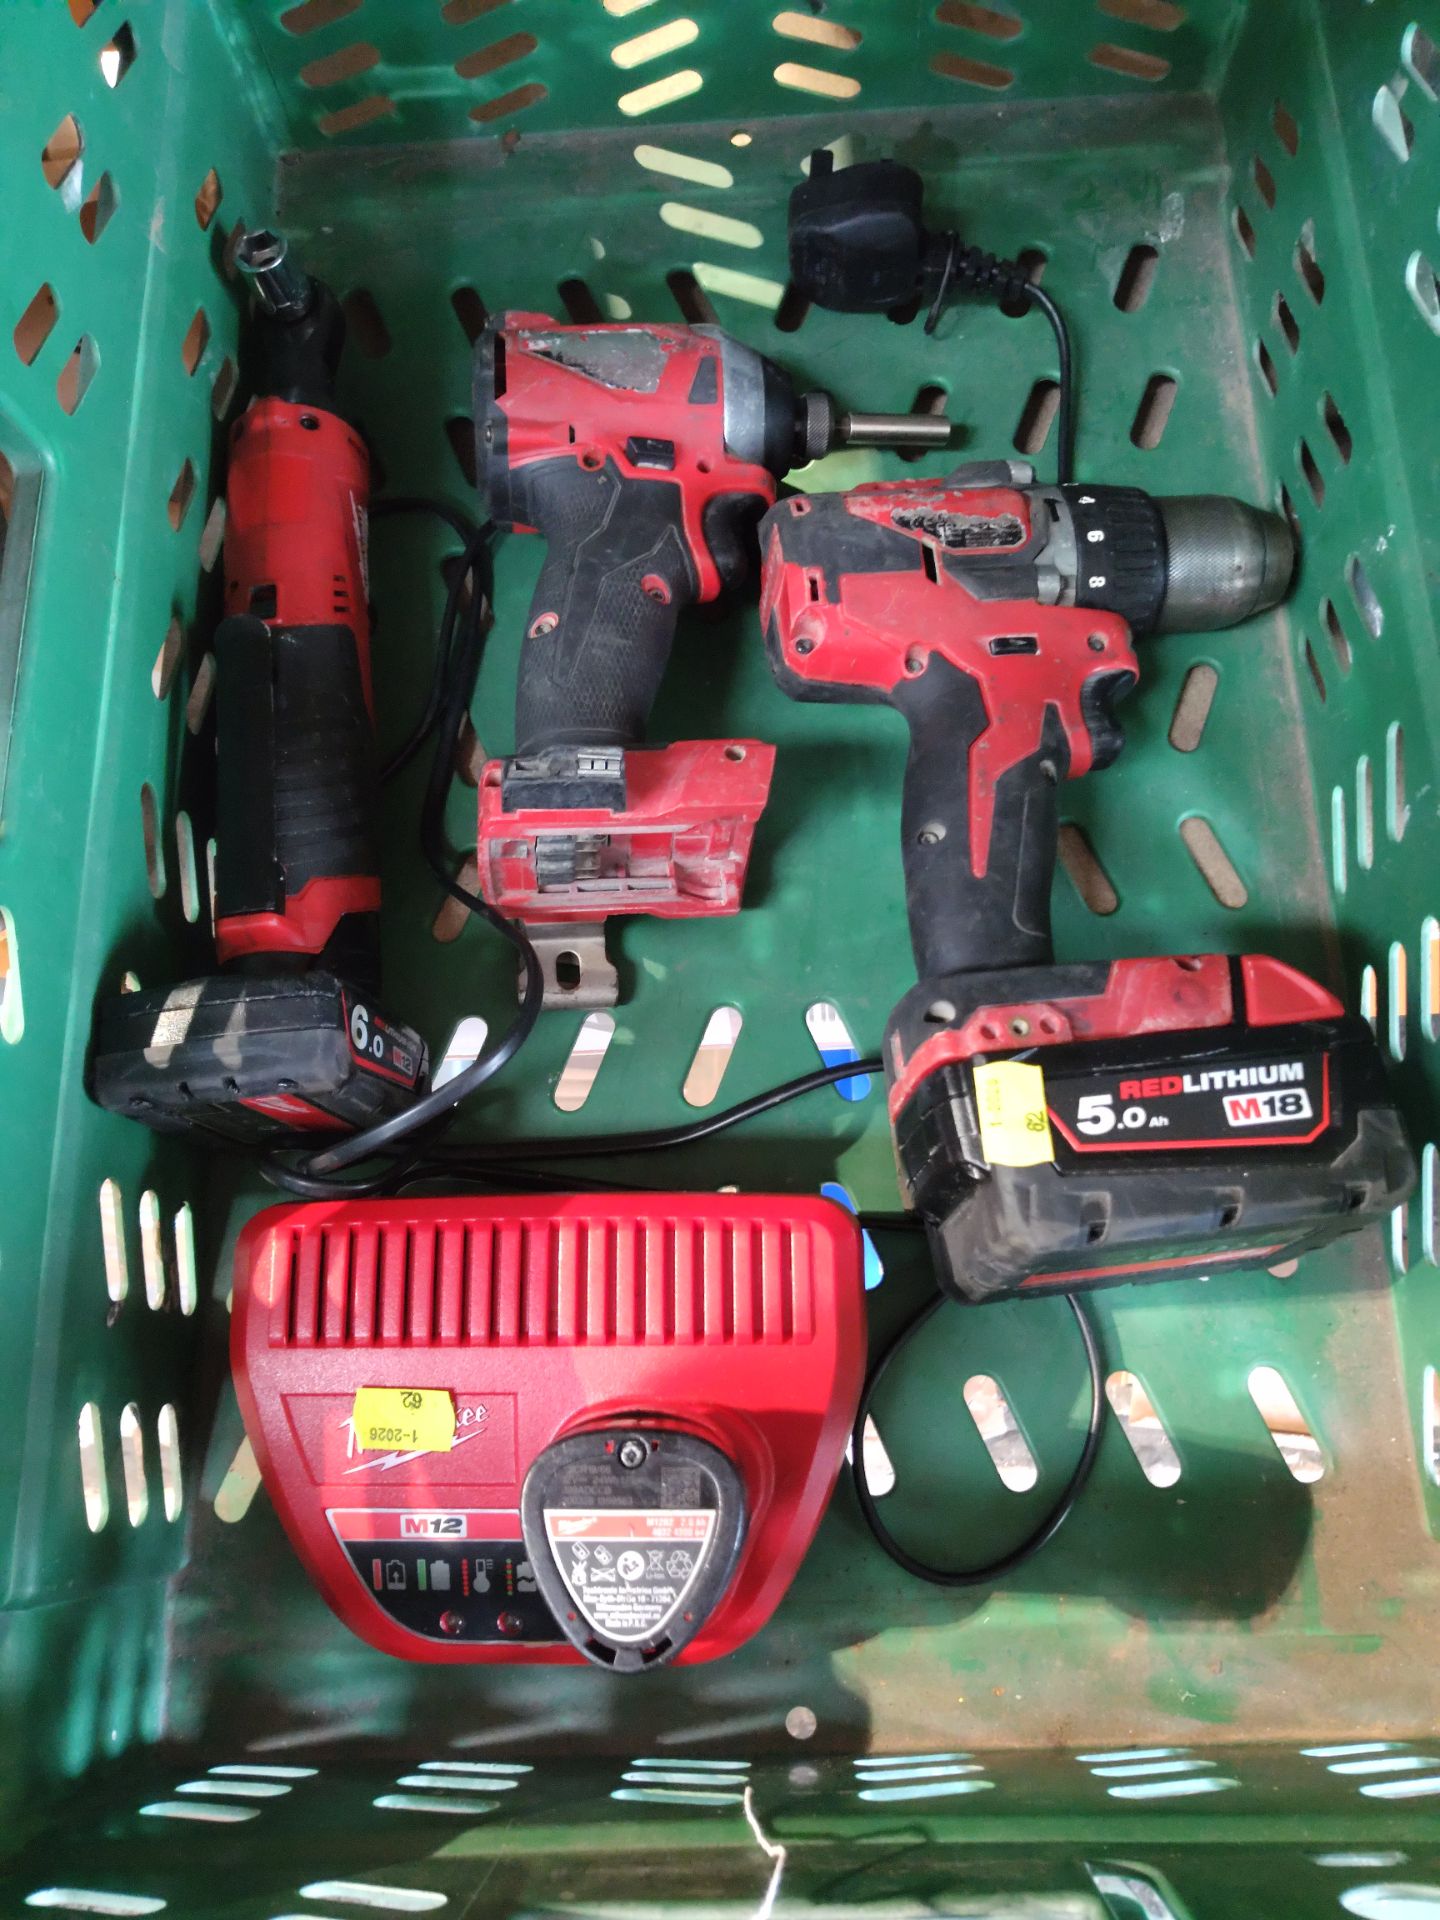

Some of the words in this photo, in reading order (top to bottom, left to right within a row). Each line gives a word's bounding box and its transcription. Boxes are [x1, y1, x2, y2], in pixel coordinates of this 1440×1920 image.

[1087, 530, 1105, 543] 6
[1089, 576, 1106, 589] 8
[351, 1004, 384, 1058] 6.0
[1119, 1062, 1304, 1100] REDLITHIUM
[1076, 1094, 1147, 1136] 5.0
[1149, 1115, 1170, 1128] Ah
[1229, 1093, 1305, 1121] M18
[369, 1427, 418, 1443] 1-2026
[405, 1517, 463, 1534] M12
